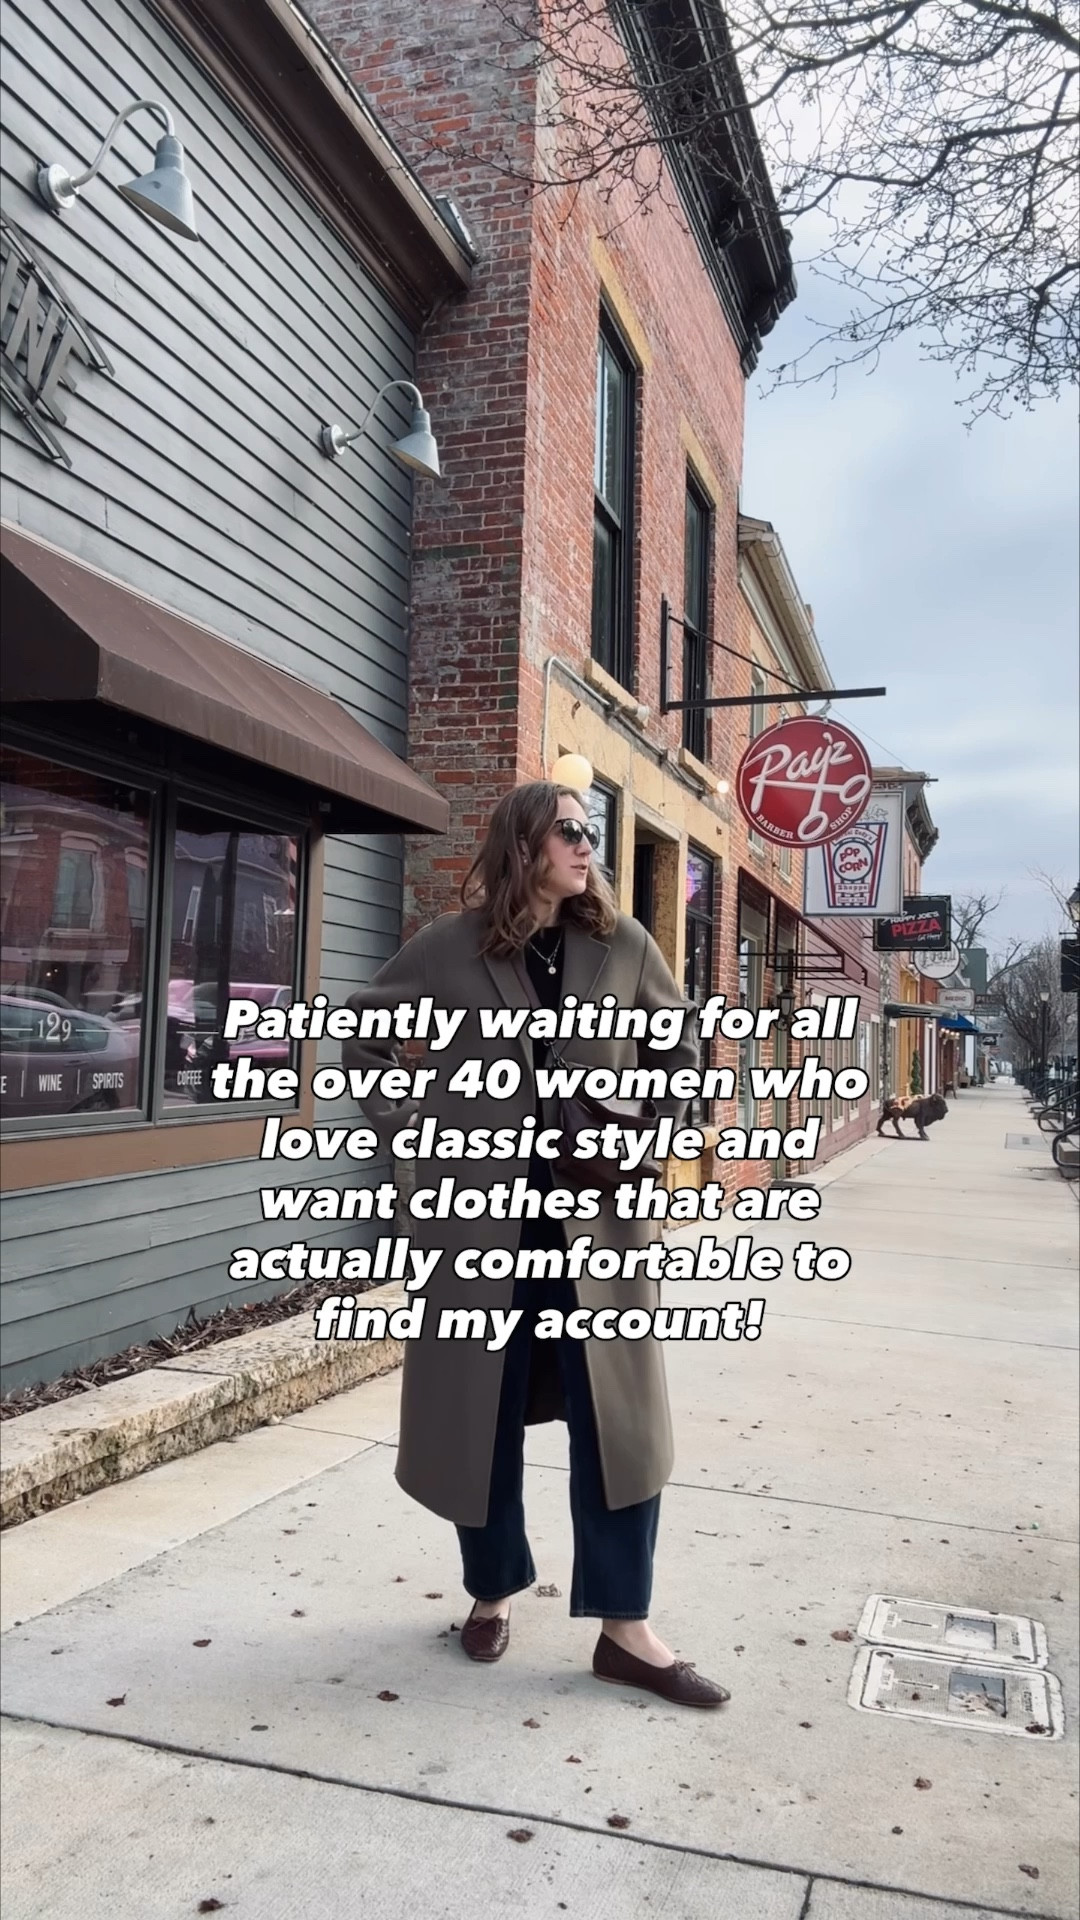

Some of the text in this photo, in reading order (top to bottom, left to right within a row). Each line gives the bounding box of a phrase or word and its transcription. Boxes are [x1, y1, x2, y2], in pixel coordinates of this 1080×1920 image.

[756, 814, 794, 839] BARBER
[830, 806, 853, 831] SHOP
[839, 847, 861, 862] POP
[838, 858, 869, 873] CORN
[891, 918, 942, 937] PIZZA
[38, 1012, 71, 1042] 129
[38, 1074, 63, 1092] WINE
[92, 1072, 124, 1089] SPIRITS
[177, 1070, 202, 1086] COFFEE
